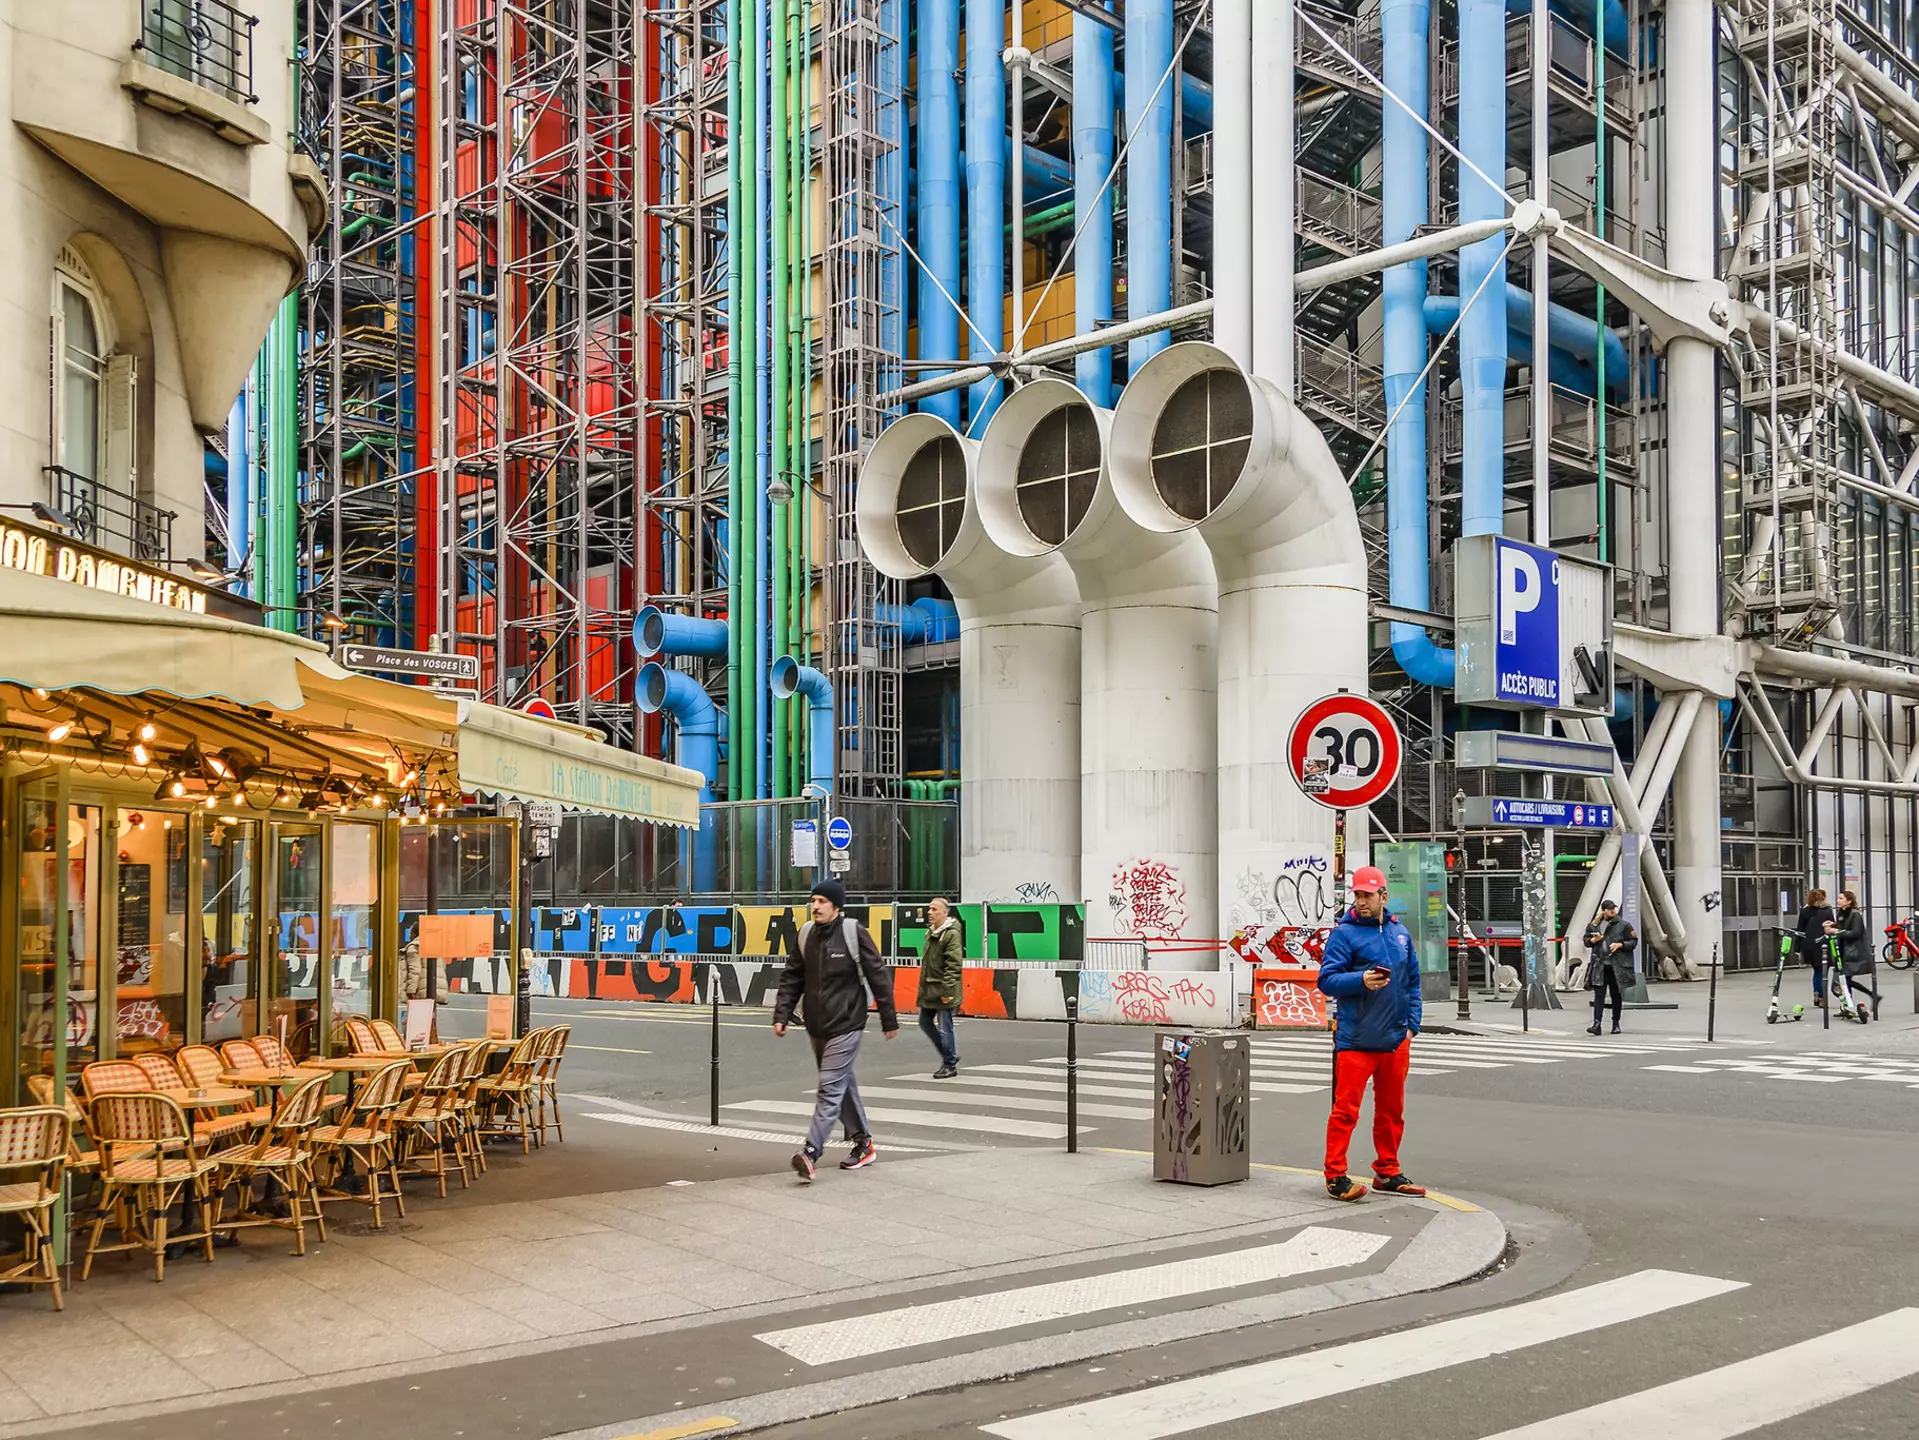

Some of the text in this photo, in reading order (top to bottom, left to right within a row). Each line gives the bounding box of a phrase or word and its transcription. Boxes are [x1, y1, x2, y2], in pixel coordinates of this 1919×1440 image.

[1501, 546, 1541, 645] P
[376, 654, 458, 671] Place des VOSGES
[1501, 671, 1556, 699] ACCÈS PUBLIC
[1315, 727, 1379, 777] 30
[1509, 802, 1534, 814] AUTOCARS
[1539, 804, 1565, 816] LIVRAISONS
